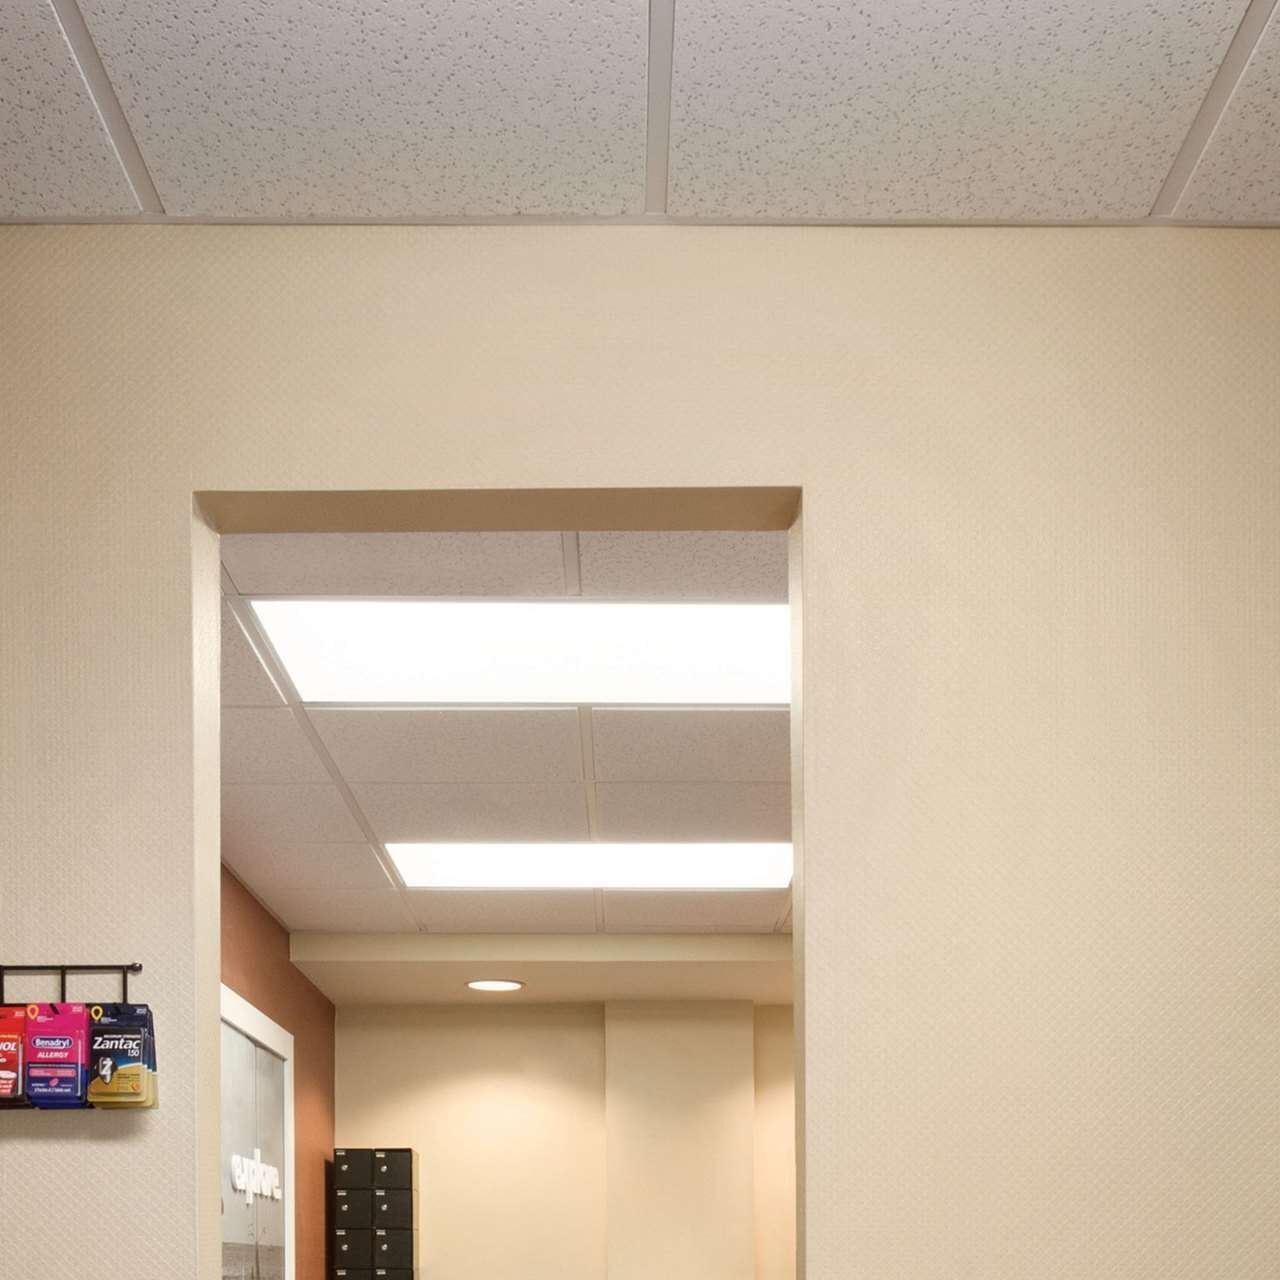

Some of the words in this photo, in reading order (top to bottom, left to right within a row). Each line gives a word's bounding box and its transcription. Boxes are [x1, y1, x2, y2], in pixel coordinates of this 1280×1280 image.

[35, 1038, 70, 1050] Benadryl
[93, 1037, 141, 1050] Zantac
[37, 1051, 70, 1059] ALLERGY
[127, 1050, 140, 1058] 150
